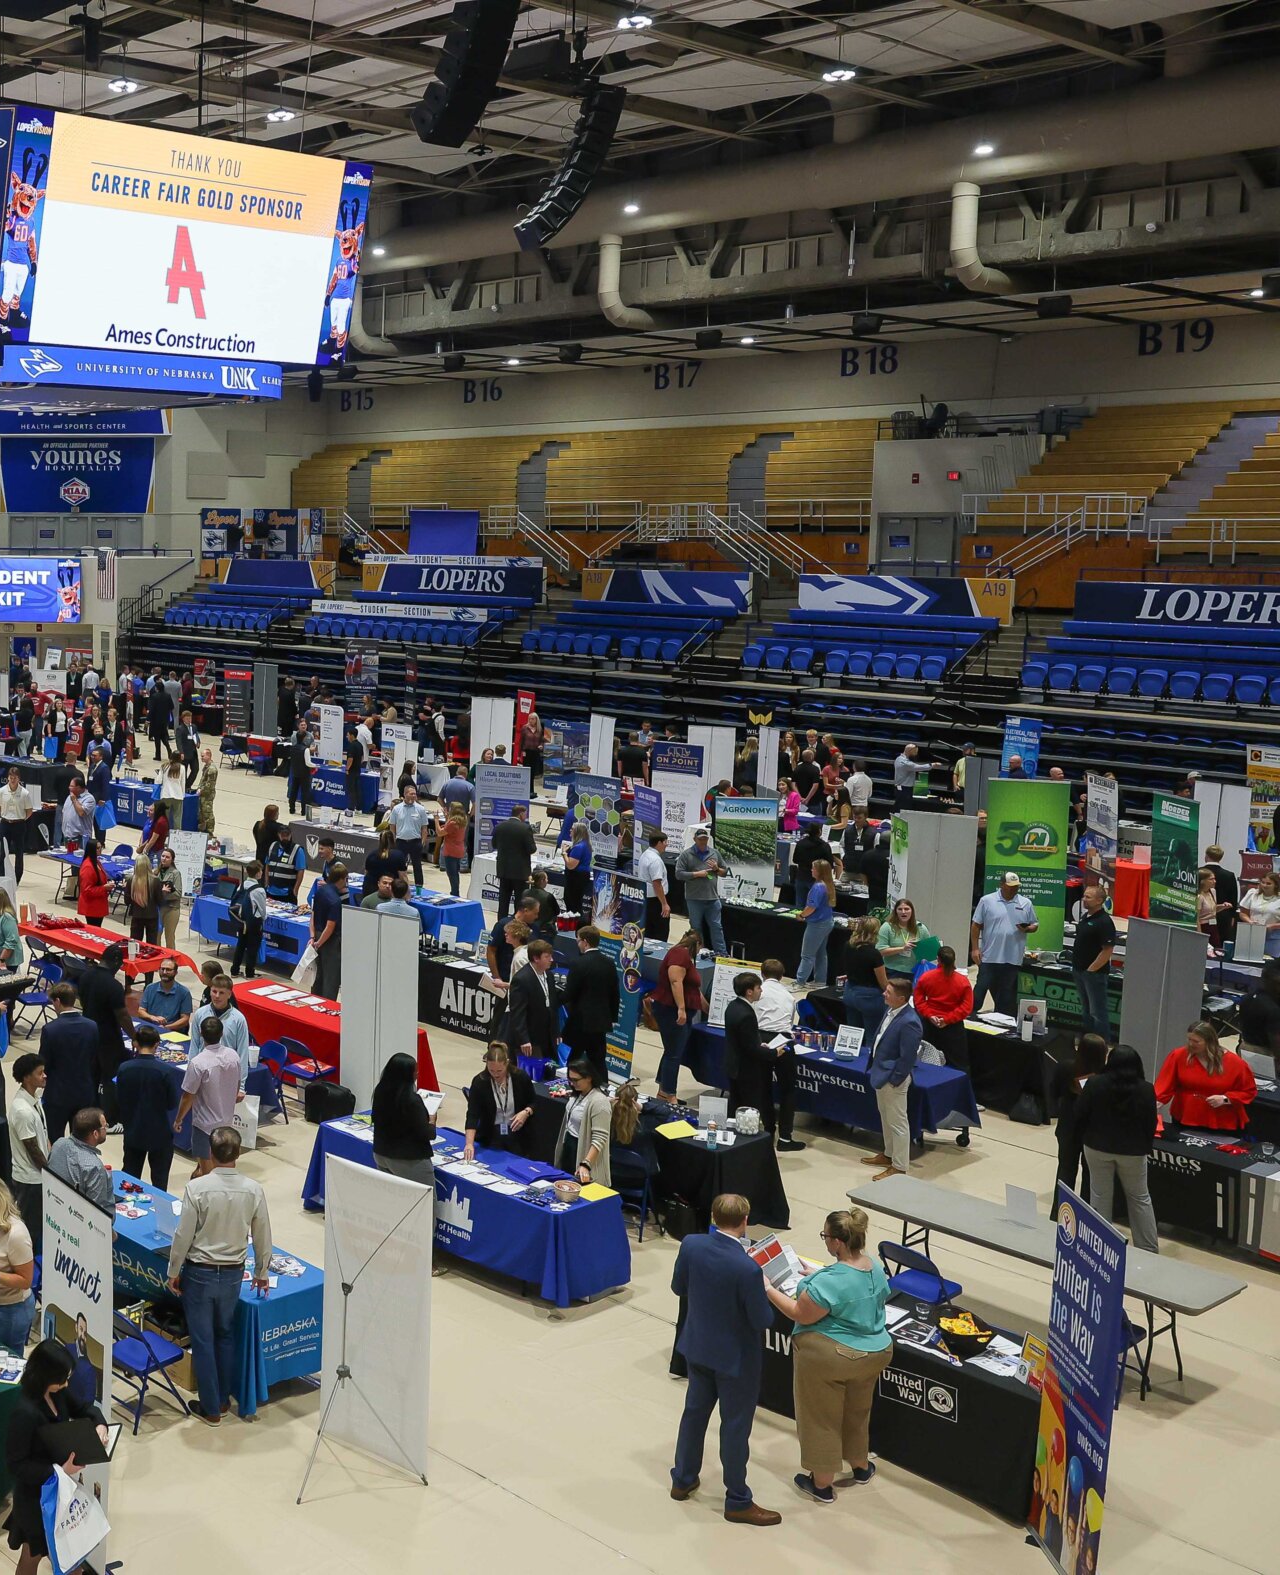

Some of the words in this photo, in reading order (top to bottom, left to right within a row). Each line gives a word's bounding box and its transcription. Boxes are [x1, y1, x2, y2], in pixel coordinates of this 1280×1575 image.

[170, 150, 212, 174] THANK
[217, 158, 241, 178] YOU
[91, 172, 150, 199] CAREER
[157, 182, 191, 205] FAIR
[197, 188, 233, 211] GOLD
[239, 194, 303, 220] SPONSOR
[105, 323, 152, 345] Ames
[155, 328, 256, 353] Construction
[76, 363, 143, 376] UNIVERSITY
[146, 367, 160, 376] OF
[163, 368, 215, 380] NEBRASKA
[221, 366, 259, 391] UNK
[30, 449, 122, 470] younes
[62, 487, 88, 496] MIAA
[414, 555, 442, 564] STUDENT
[458, 556, 486, 565] SECTION
[418, 568, 506, 593] LOPERS
[360, 605, 387, 614] STUDENT
[404, 607, 431, 616] SECTION
[656, 756, 669, 764] ON
[671, 758, 699, 767] POINT
[723, 806, 771, 815] AGRONOMY
[1162, 800, 1190, 816] NORDER
[1173, 881, 1184, 889] OUR
[1176, 868, 1197, 882] JOIN
[620, 883, 645, 900] Airgas
[449, 1017, 460, 1027] Air
[461, 1019, 487, 1034] Liquide
[45, 1213, 61, 1234] Make
[62, 1231, 66, 1239] a
[67, 1232, 80, 1248] real
[438, 1222, 447, 1232] of
[447, 1223, 471, 1241] Health
[1078, 1220, 1103, 1256] UNITED
[1104, 1244, 1120, 1272] WAY
[54, 1238, 102, 1304] impact
[1076, 1243, 1099, 1273] Kearney
[1098, 1266, 1111, 1284] Area
[1053, 1250, 1090, 1307] United
[1092, 1283, 1103, 1325] is
[1050, 1292, 1068, 1334] the
[282, 1337, 298, 1347] Great
[299, 1332, 320, 1342] Service
[882, 1370, 923, 1392] United
[898, 1385, 923, 1406] Way
[1077, 1430, 1104, 1472] uwka.org
